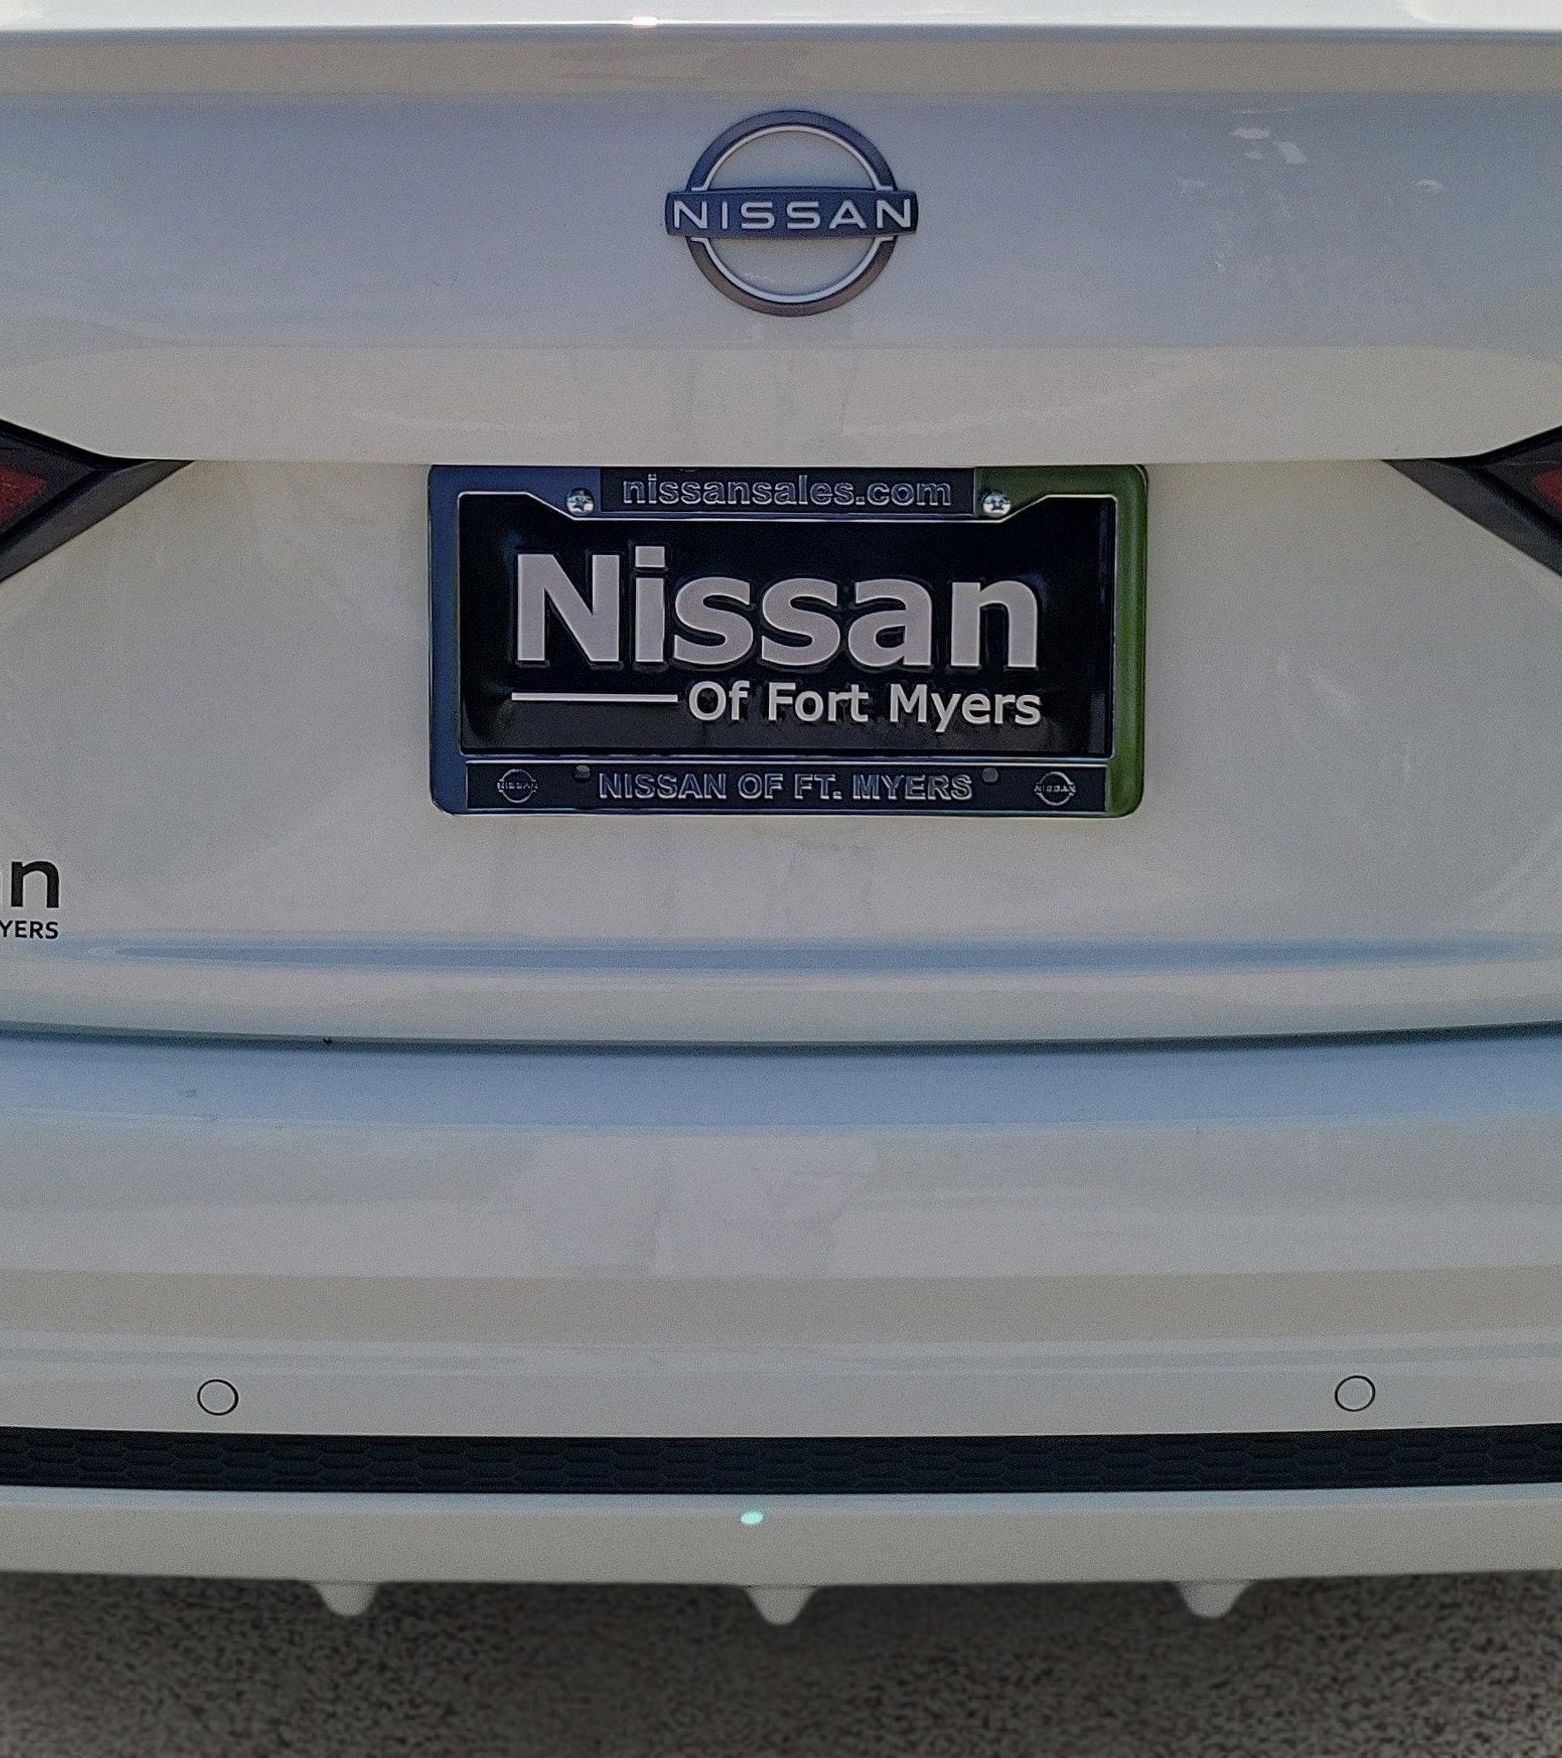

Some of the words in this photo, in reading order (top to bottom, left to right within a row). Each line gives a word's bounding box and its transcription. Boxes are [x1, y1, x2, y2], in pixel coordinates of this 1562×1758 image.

[673, 199, 912, 230] NISSAN
[623, 474, 951, 506] nissansales.com
[516, 546, 1039, 670] Nissan
[688, 681, 750, 722] Of
[768, 682, 869, 723] Fort
[889, 683, 1041, 732] Myers
[598, 772, 727, 800] NISSAN
[738, 773, 784, 800] OF
[794, 773, 842, 801] FT.
[852, 774, 973, 801] MYERS
